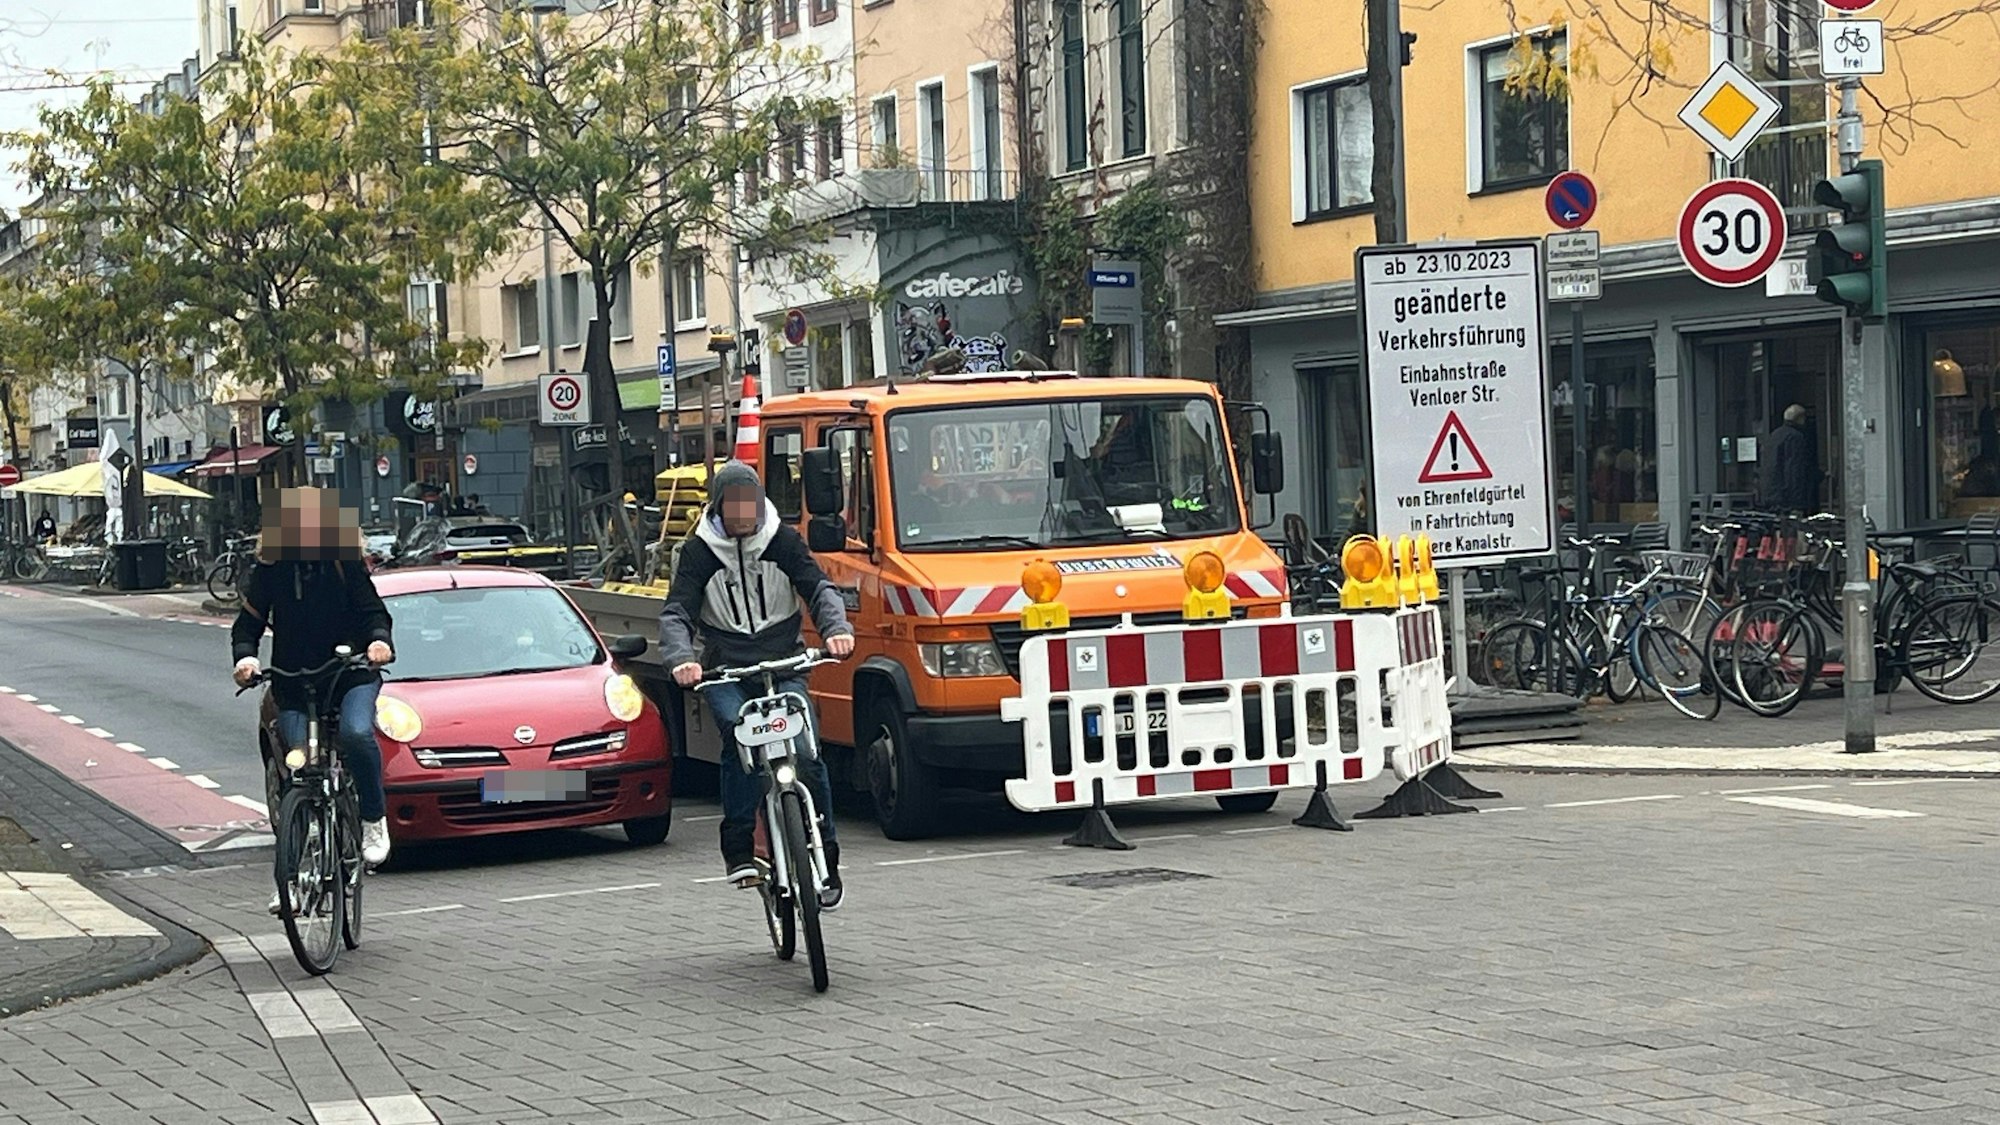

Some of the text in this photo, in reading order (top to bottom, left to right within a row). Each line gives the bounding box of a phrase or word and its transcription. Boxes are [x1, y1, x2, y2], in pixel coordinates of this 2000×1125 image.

[1843, 56, 1863, 68] frei
[1702, 208, 1761, 256] 30
[1384, 251, 1511, 275] ab 23.10.2023
[1551, 273, 1596, 283] werktags
[1394, 284, 1507, 323] geänderte
[1378, 325, 1526, 352] Verkehrsführung
[660, 348, 669, 372] P
[1400, 360, 1507, 384] Einbahnstraße
[555, 386, 574, 402] 20
[1410, 384, 1500, 407] Venloer Str.
[552, 412, 578, 421] ZONE
[1397, 484, 1526, 509] von Ehrenfeldgürtel
[1411, 512, 1514, 531] in Fahrtrichtung
[1431, 533, 1516, 553] ere Kanalstr.
